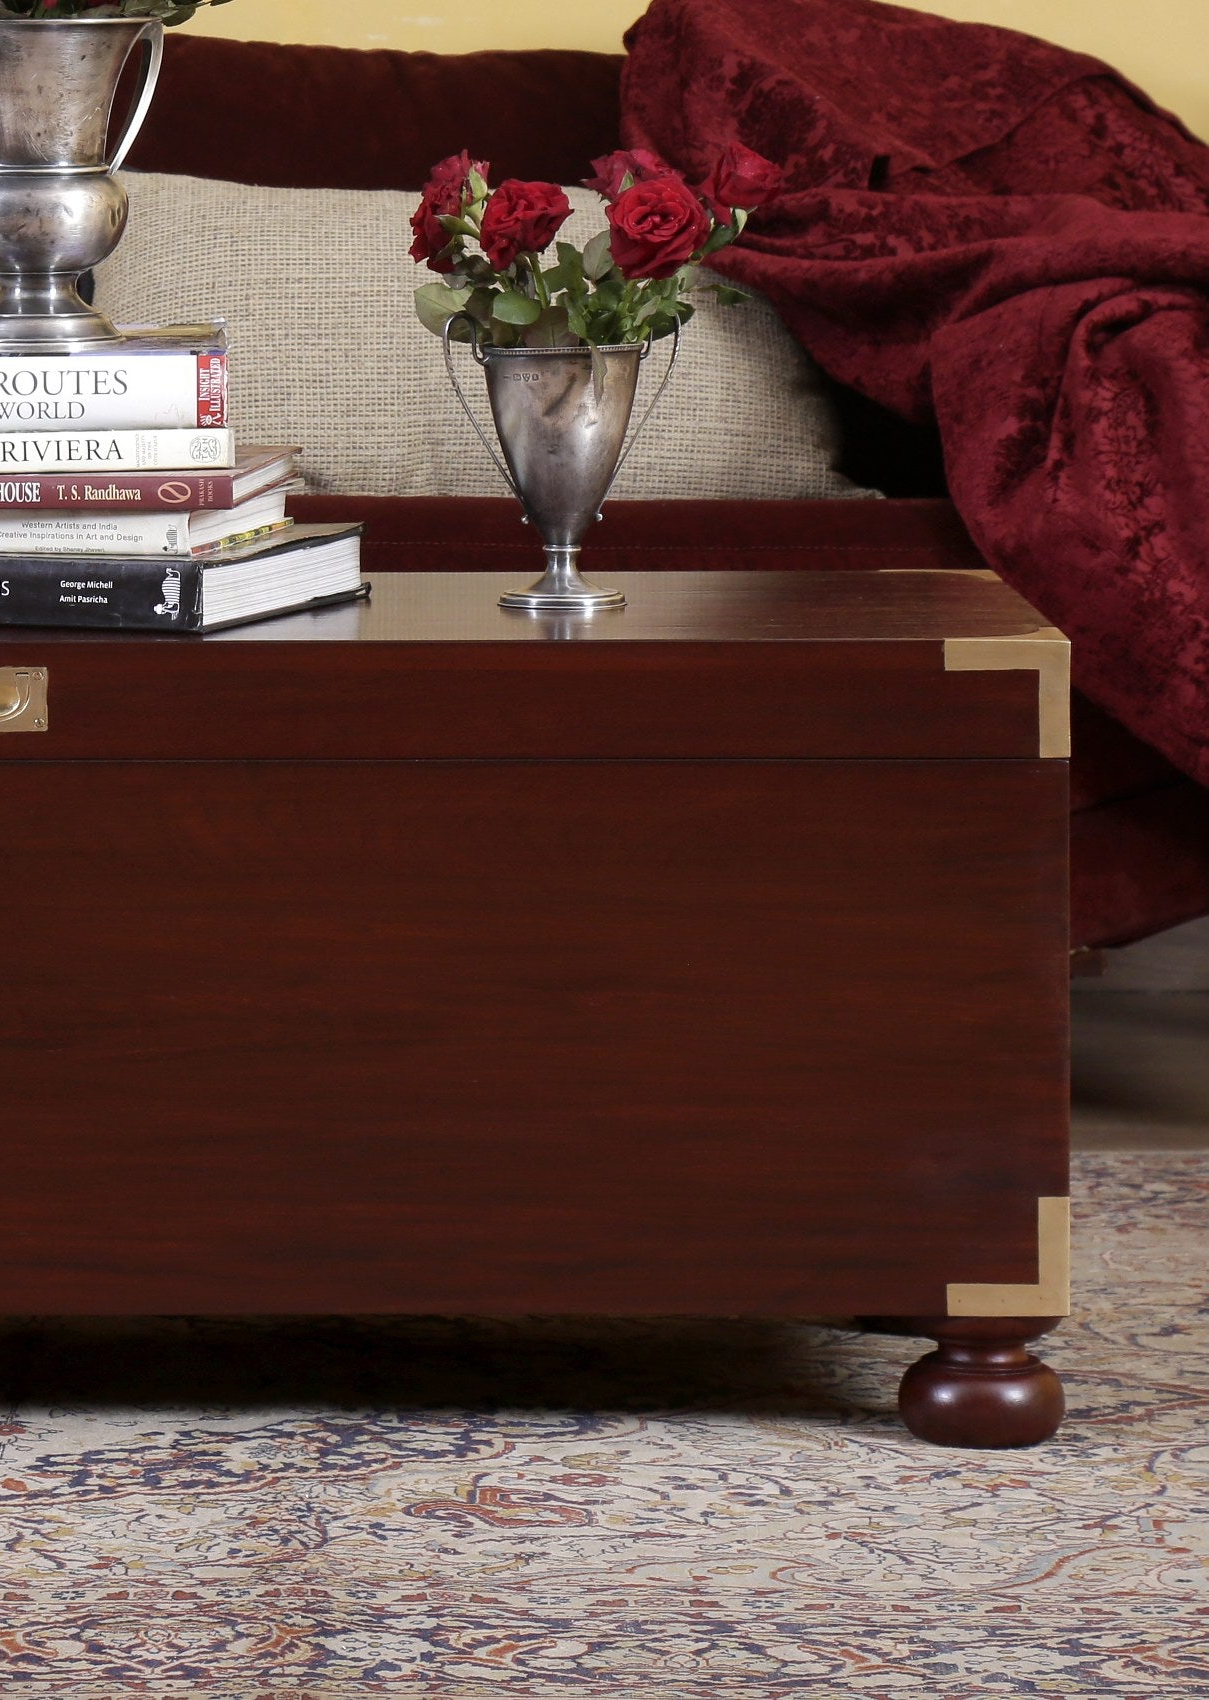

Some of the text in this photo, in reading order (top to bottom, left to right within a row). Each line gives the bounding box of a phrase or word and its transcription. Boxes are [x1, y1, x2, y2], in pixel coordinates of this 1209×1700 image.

[199, 367, 211, 401] INSIGHT
[209, 357, 221, 412] ILLUSTRATED
[0, 438, 124, 463] RIVIERA
[56, 483, 142, 501] T. S. Randhawa
[21, 521, 118, 531] Western Artists and India
[29, 531, 74, 542] Inspirations
[76, 532, 84, 540] in
[86, 532, 98, 541] Art
[100, 533, 114, 541] and
[116, 533, 144, 543] Design
[60, 580, 113, 590] George Michell
[59, 594, 108, 604] Amit Pasricha
